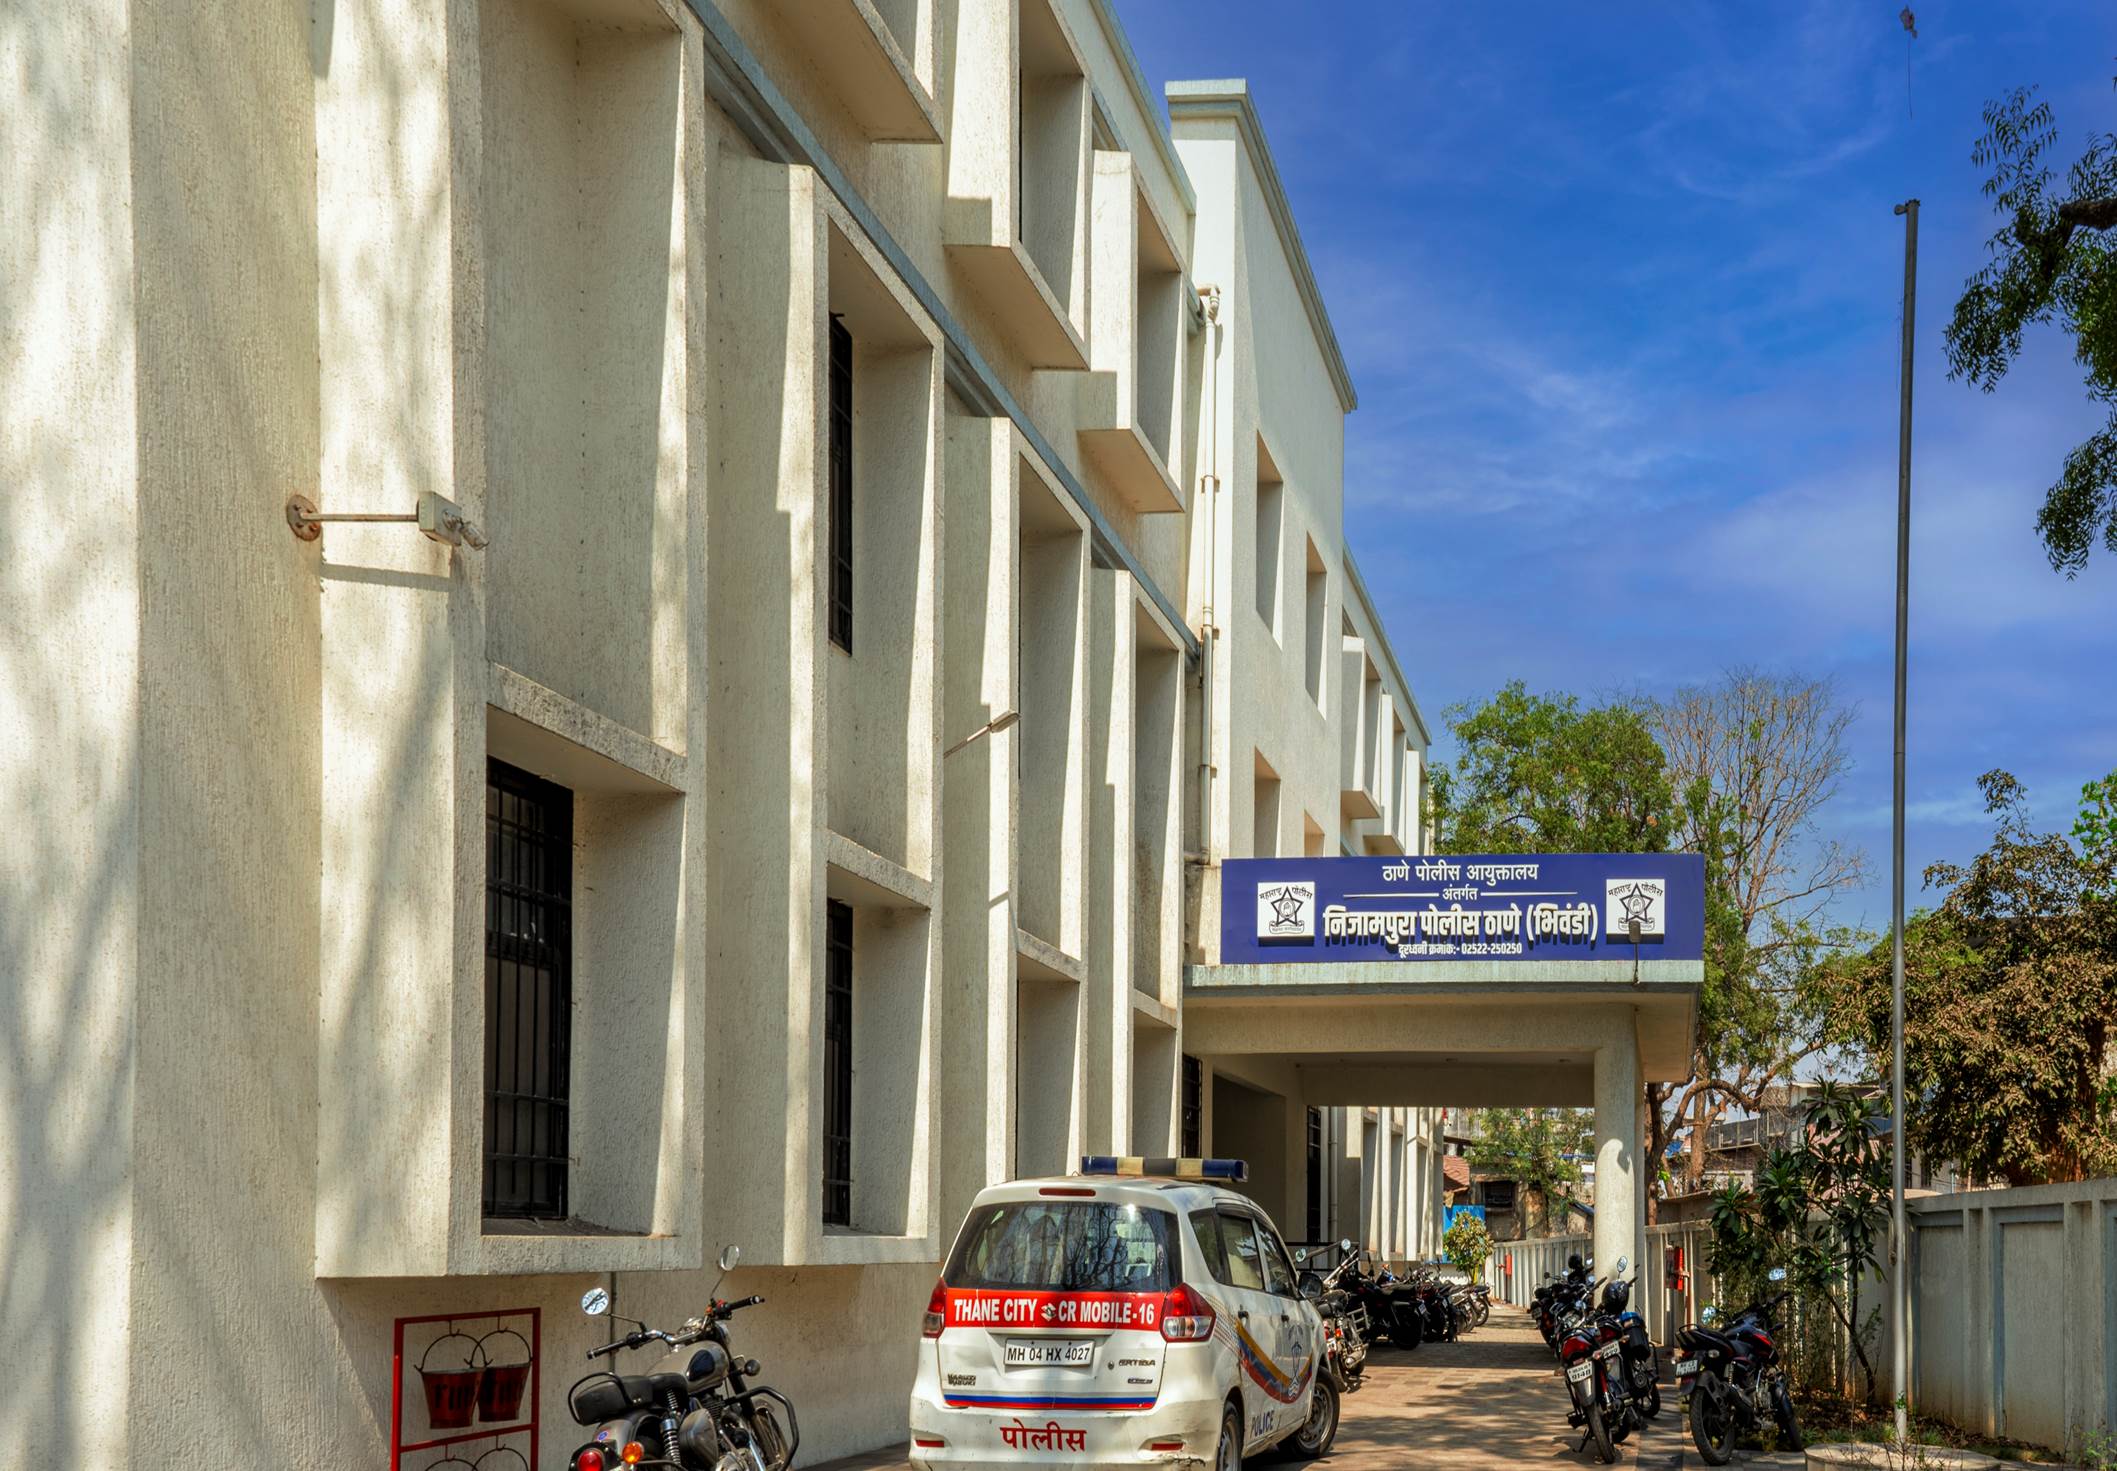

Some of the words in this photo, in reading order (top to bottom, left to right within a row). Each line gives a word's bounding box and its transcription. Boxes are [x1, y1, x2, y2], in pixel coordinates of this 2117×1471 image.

[1382, 859, 1410, 881] ठाणे
[1415, 859, 1461, 881] पोलीस
[1466, 864, 1539, 886] आयुक्तालय
[1442, 884, 1479, 900] अंतर्गत
[1322, 905, 1418, 944] निजामपुरा
[1419, 903, 1481, 936] पोलीस
[1483, 902, 1522, 935] ठाणे
[1526, 902, 1598, 941] (भिवंडी)
[1461, 943, 1522, 954] 02522-250250
[954, 1298, 1000, 1321] THANE
[1003, 1298, 1038, 1321] CITY
[1058, 1301, 1077, 1321] CR
[1007, 1347, 1025, 1361] MH
[1029, 1347, 1042, 1361] 04
[1046, 1347, 1062, 1361] HX
[1065, 1347, 1090, 1361] 4027
[999, 1417, 1087, 1451] पोलीस
